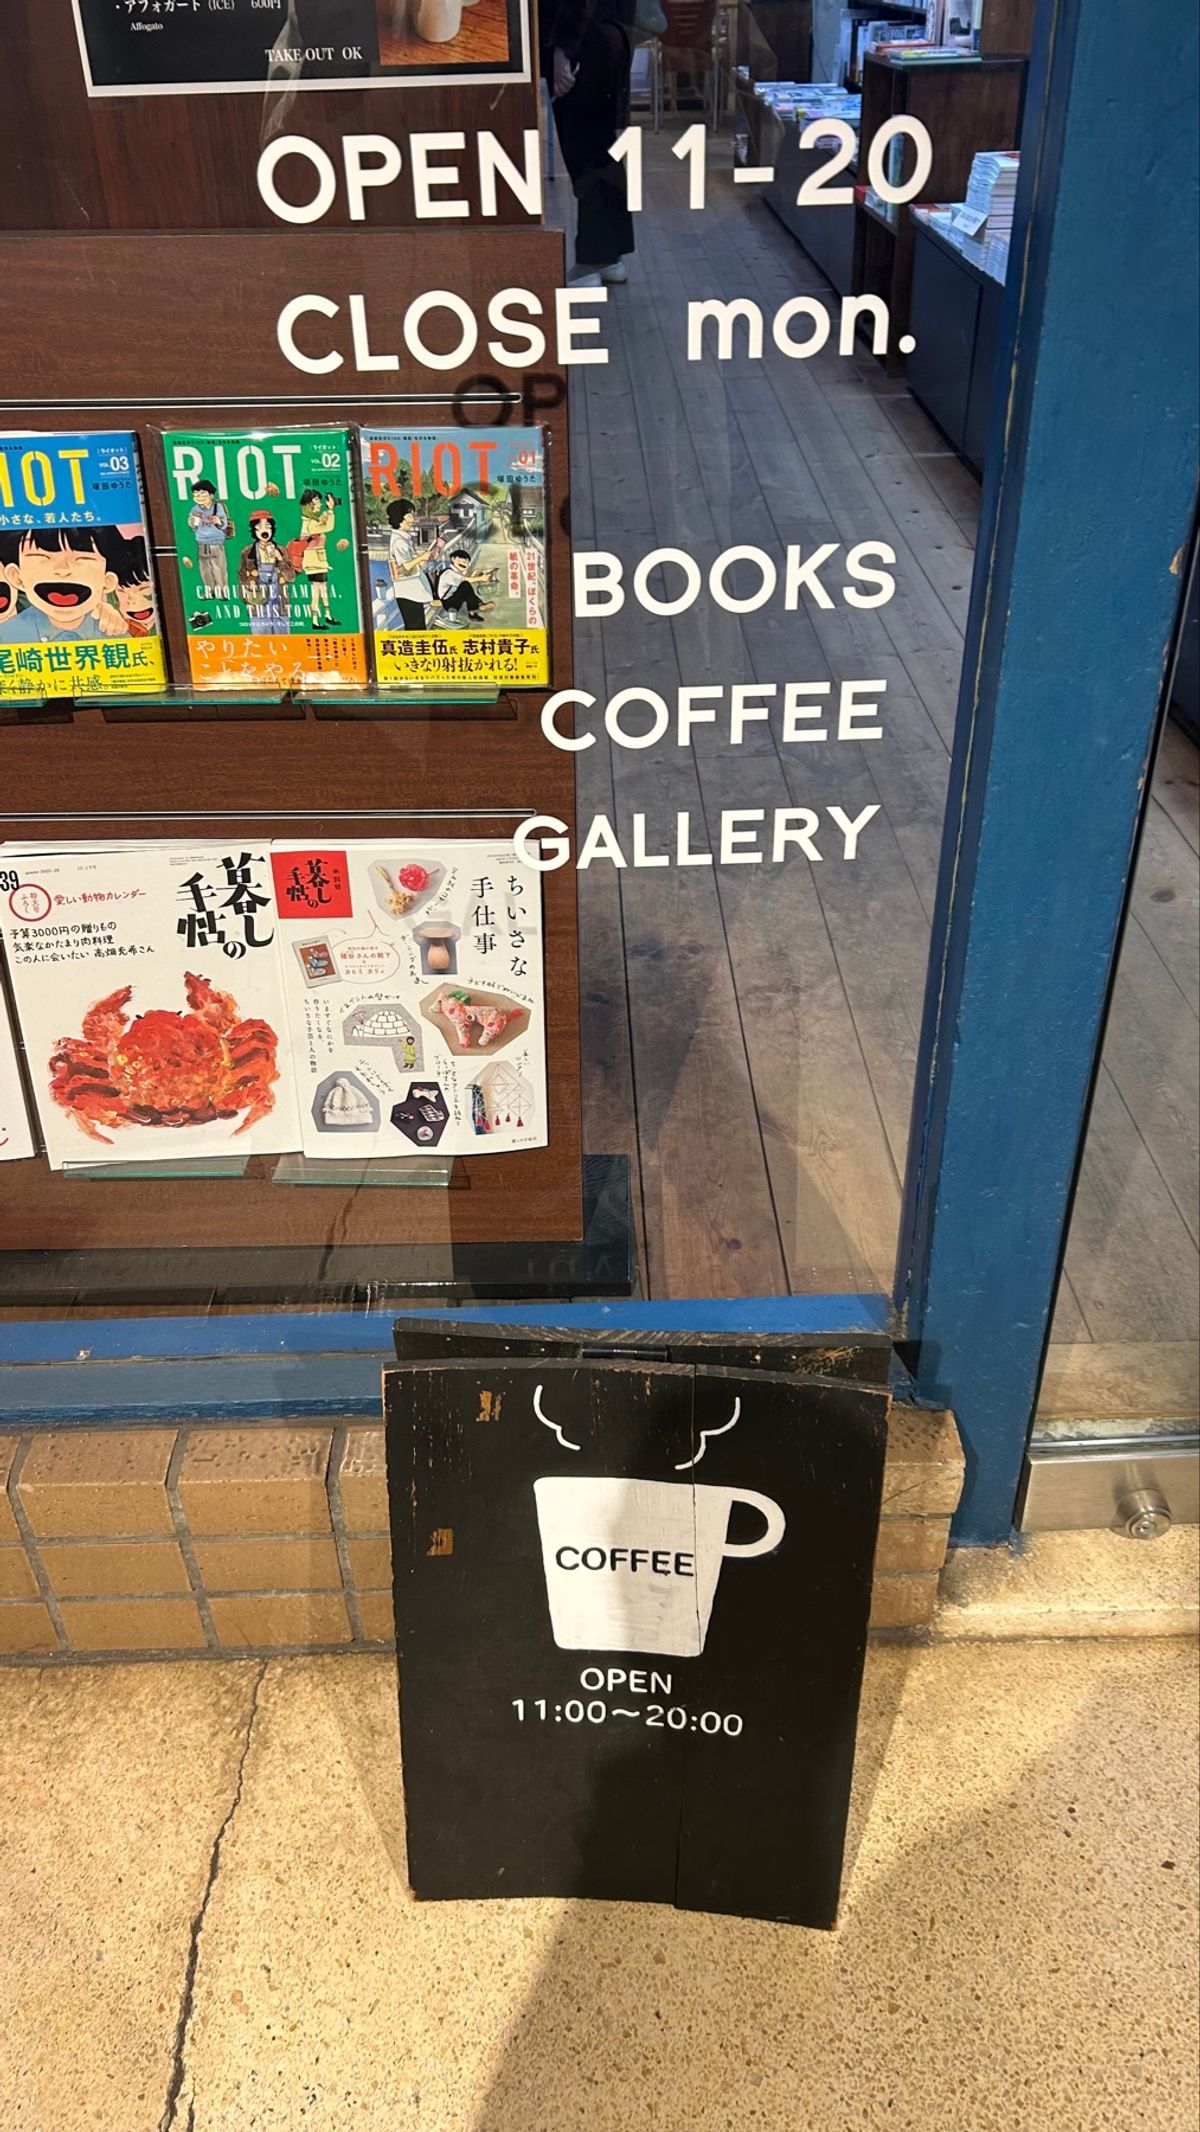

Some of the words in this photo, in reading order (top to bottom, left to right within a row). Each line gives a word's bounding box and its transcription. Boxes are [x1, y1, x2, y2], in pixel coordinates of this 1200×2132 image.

[130, 21, 164, 31] Affogato
[265, 48, 301, 62] TAKE
[305, 47, 335, 61] OUT
[342, 46, 363, 60] OK
[257, 129, 542, 224] OPEN
[608, 114, 932, 211] 11-20
[277, 286, 609, 375] CLOSE
[688, 293, 916, 361] mon.
[172, 445, 302, 500] RIOT
[368, 441, 497, 497] RIOT
[573, 541, 896, 617] BOOKS
[215, 604, 241, 619] AND
[247, 603, 280, 619] THIS
[196, 637, 289, 660] やりたい
[381, 639, 459, 656] 真造圭伍氏
[463, 638, 540, 655] 志村貴子氏
[541, 679, 887, 752] COFFEE
[513, 804, 882, 872] GALLERY
[470, 876, 498, 955] 手仕事
[507, 875, 528, 977] ちいさな
[555, 1545, 695, 1578] COFFEE
[580, 1667, 673, 1696] OPEN
